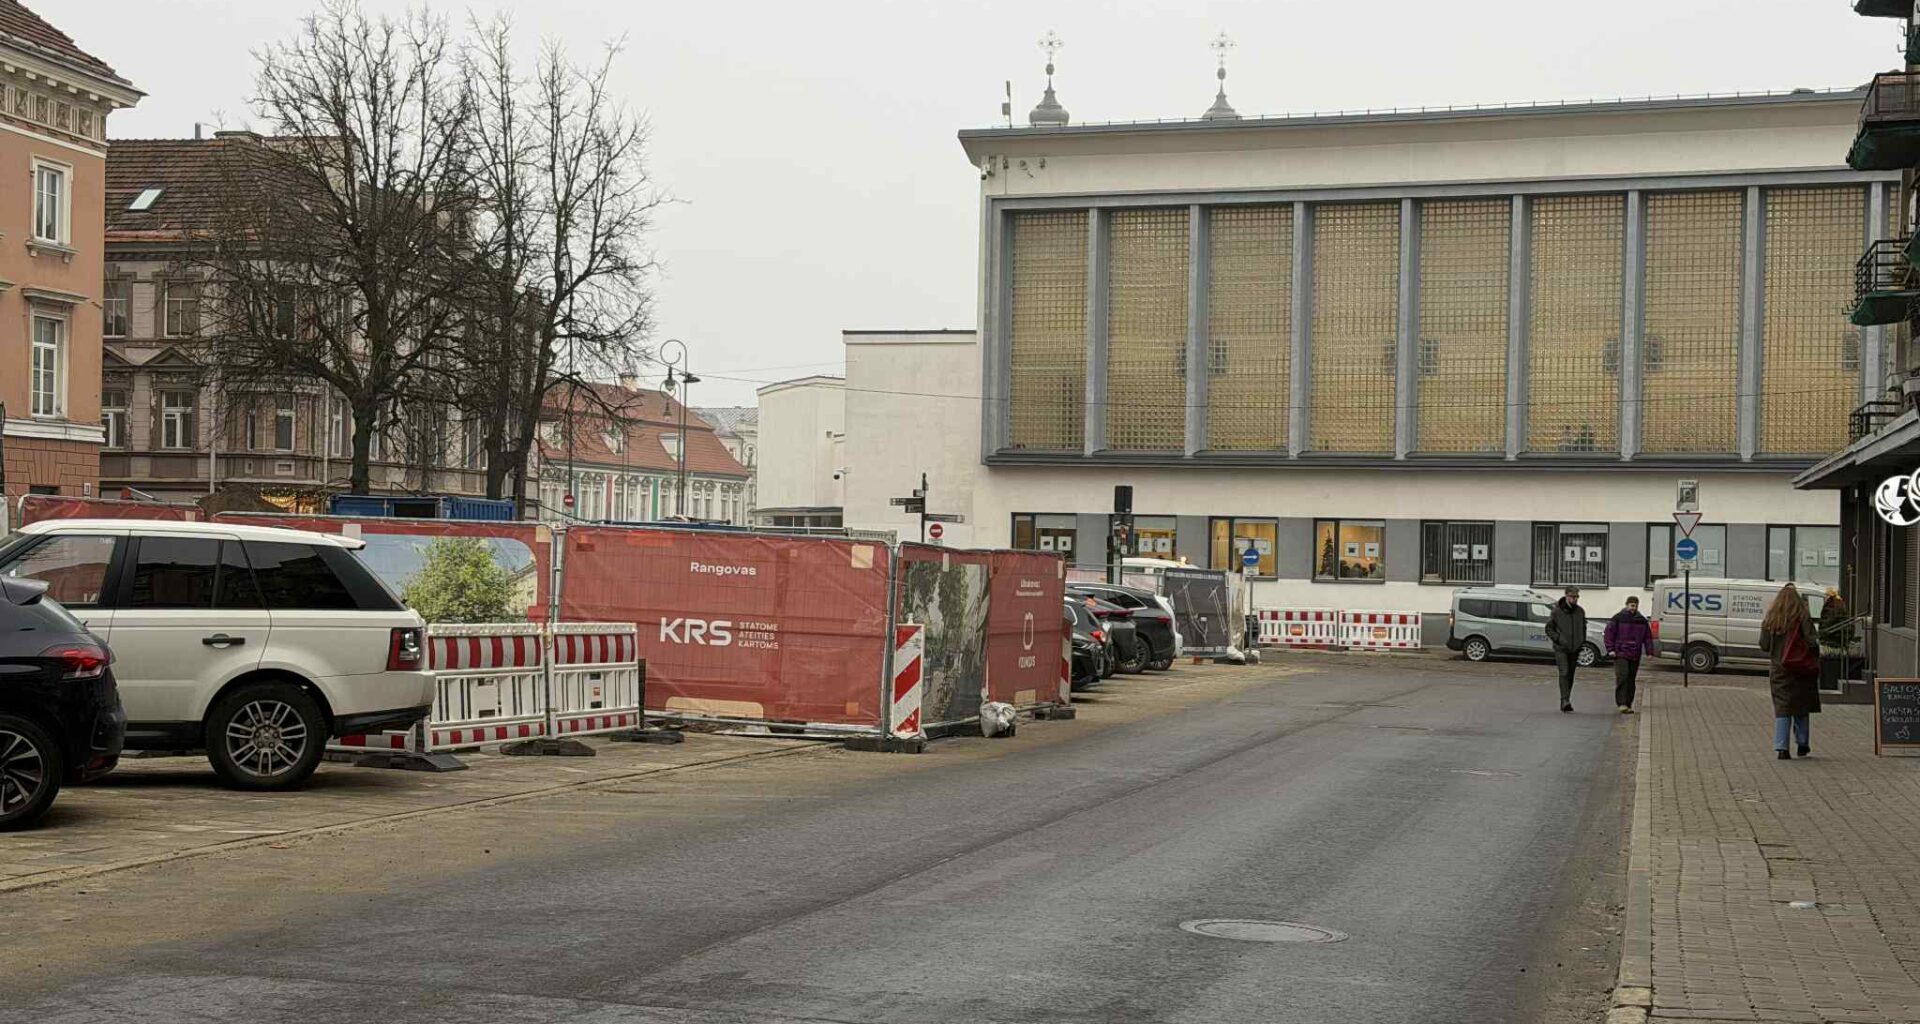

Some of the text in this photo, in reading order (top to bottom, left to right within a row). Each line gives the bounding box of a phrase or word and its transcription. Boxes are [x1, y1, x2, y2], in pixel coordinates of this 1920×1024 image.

[690, 561, 757, 576] Rangovas
[1667, 592, 1722, 611] KRS
[659, 616, 733, 647] KRS
[738, 621, 779, 632] STATOME
[738, 631, 776, 641] ATEITIES
[738, 640, 779, 650] KARTOMS
